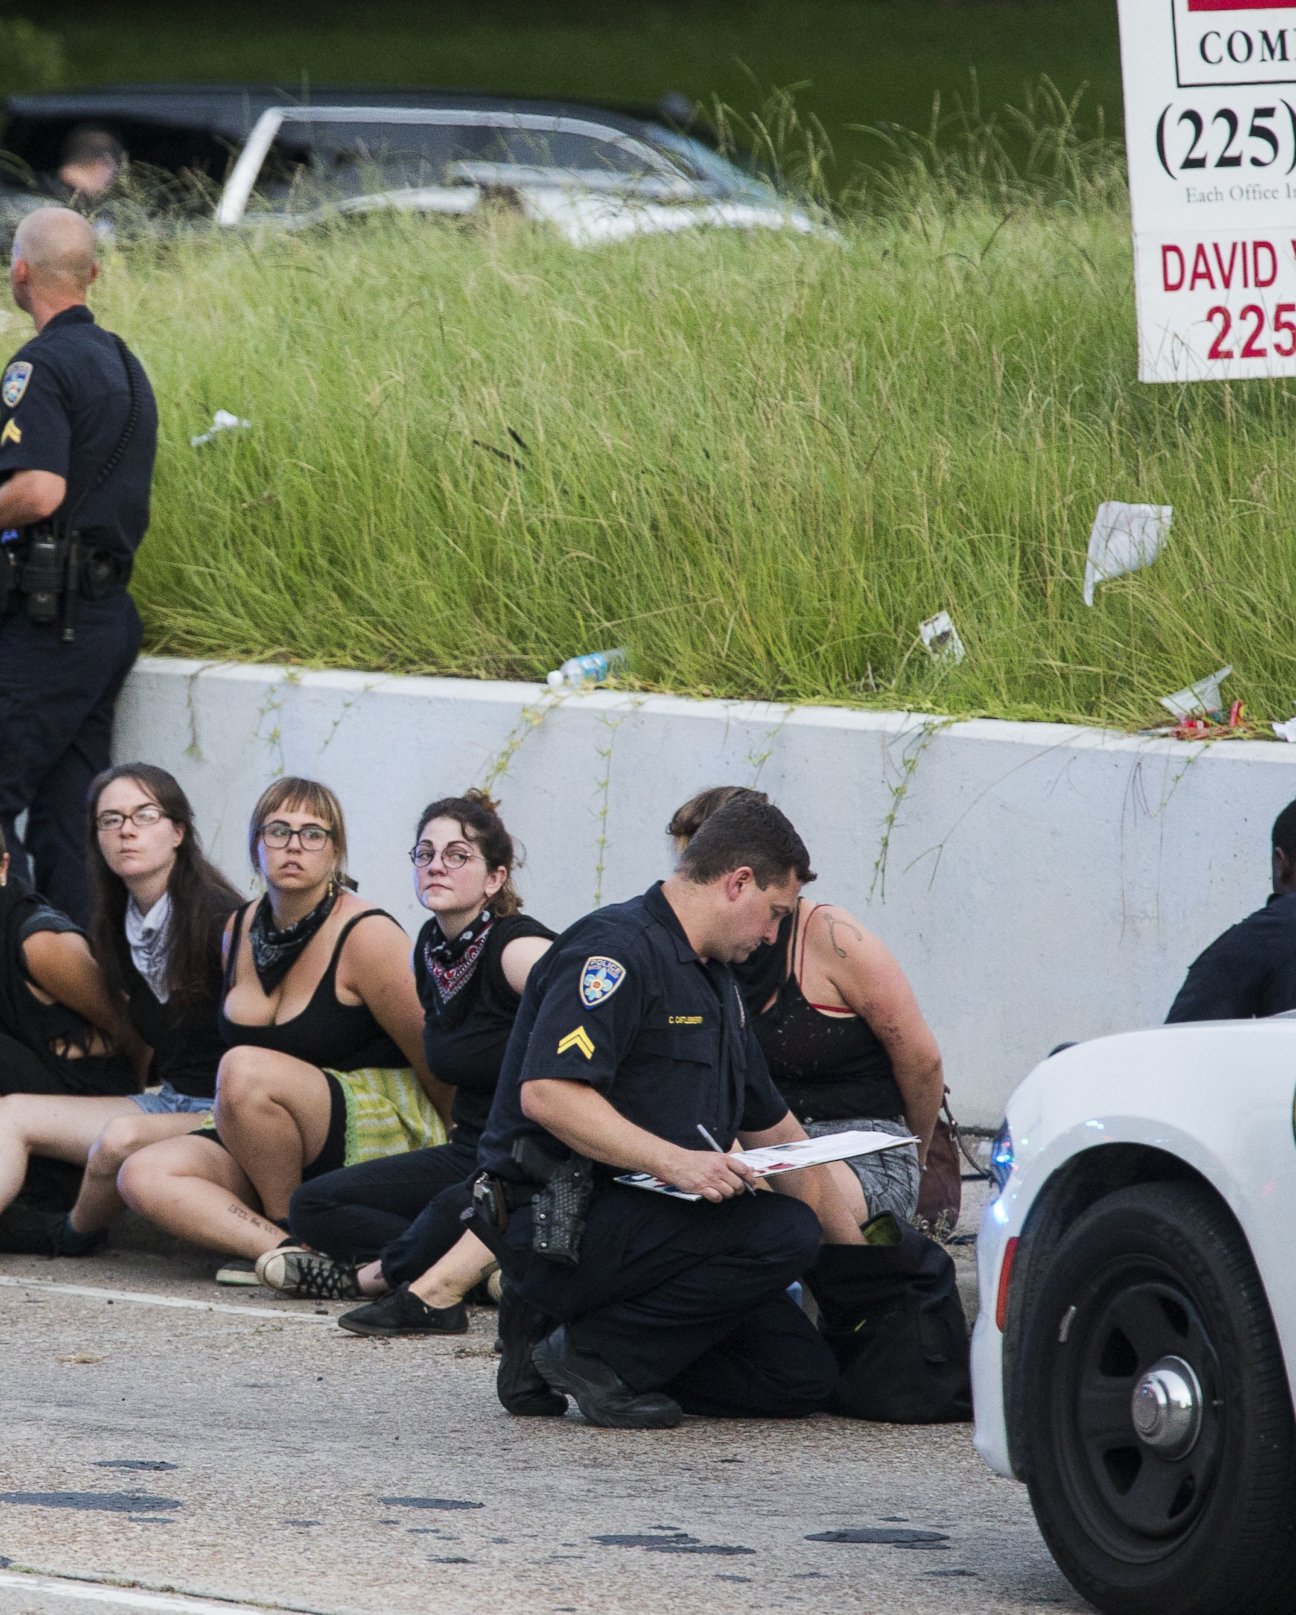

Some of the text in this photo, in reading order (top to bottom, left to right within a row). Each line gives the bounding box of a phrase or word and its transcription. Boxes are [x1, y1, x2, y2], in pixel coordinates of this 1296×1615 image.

[1199, 29, 1296, 65] COM
[1185, 186, 1225, 204] Each
[1229, 183, 1280, 201] Office
[1161, 240, 1278, 293] DAVID
[1206, 303, 1296, 360] 225
